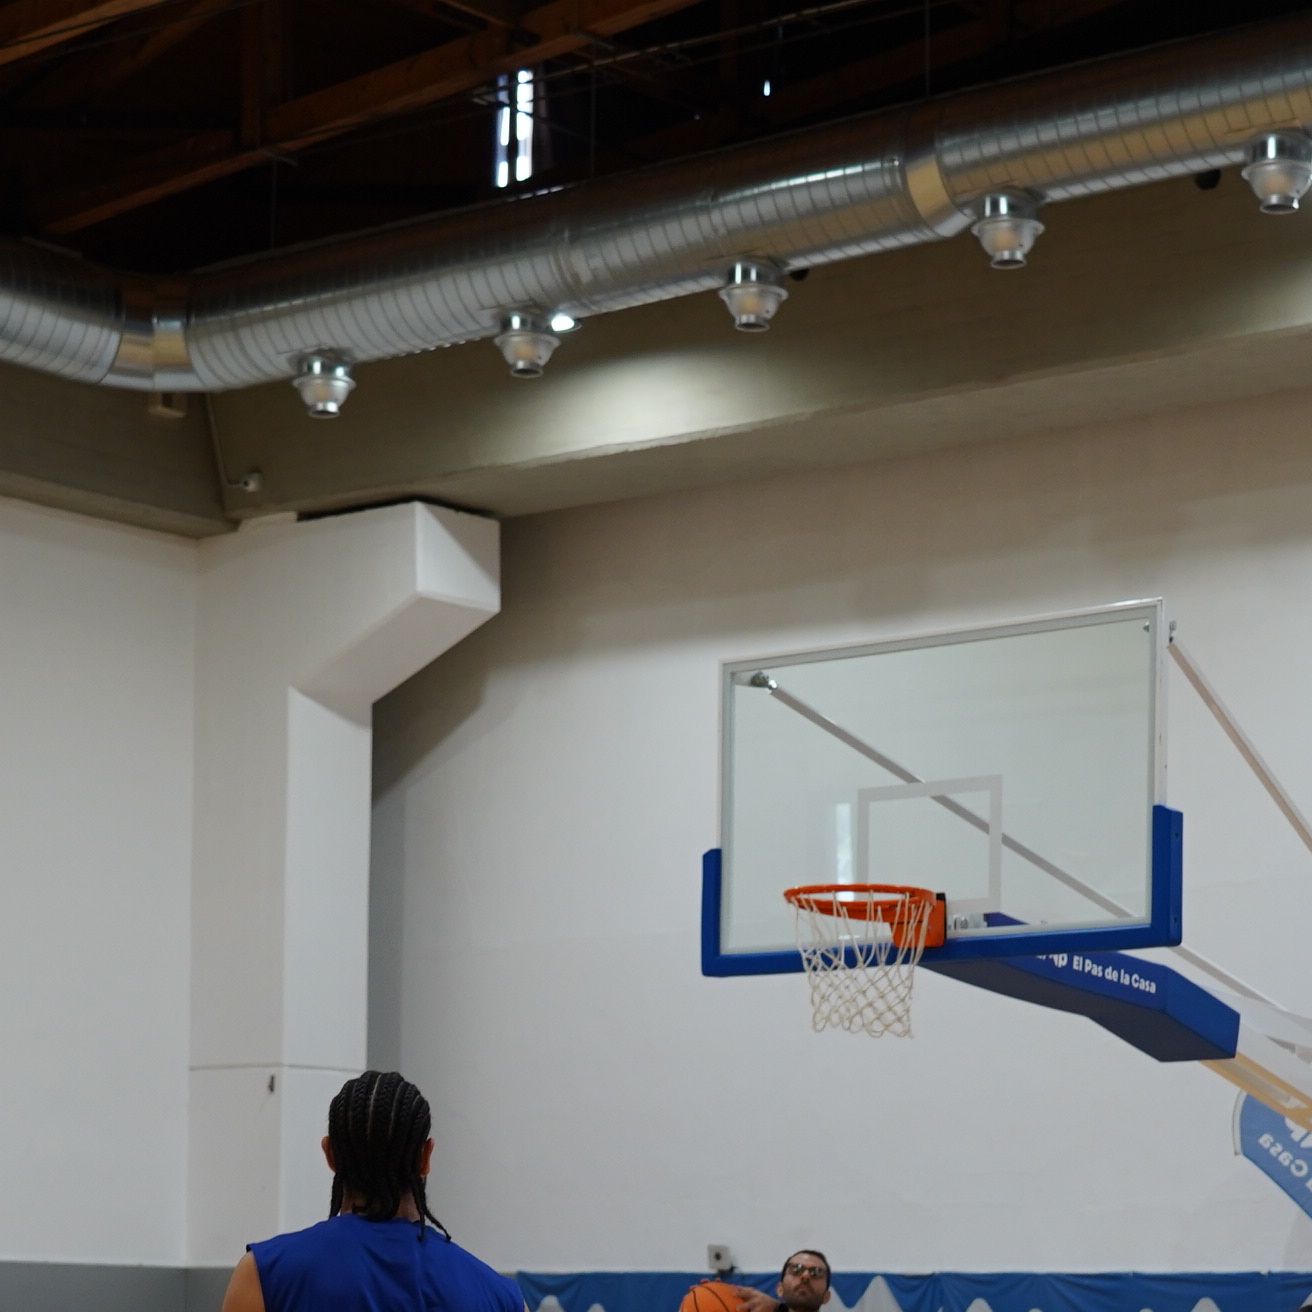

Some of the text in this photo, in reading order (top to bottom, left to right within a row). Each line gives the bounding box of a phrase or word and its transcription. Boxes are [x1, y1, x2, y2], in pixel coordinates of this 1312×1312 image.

[1073, 955, 1083, 971] El
[1084, 959, 1103, 978] Pas
[1104, 966, 1119, 982] de
[1120, 969, 1129, 986] la
[1131, 973, 1156, 994] Casa
